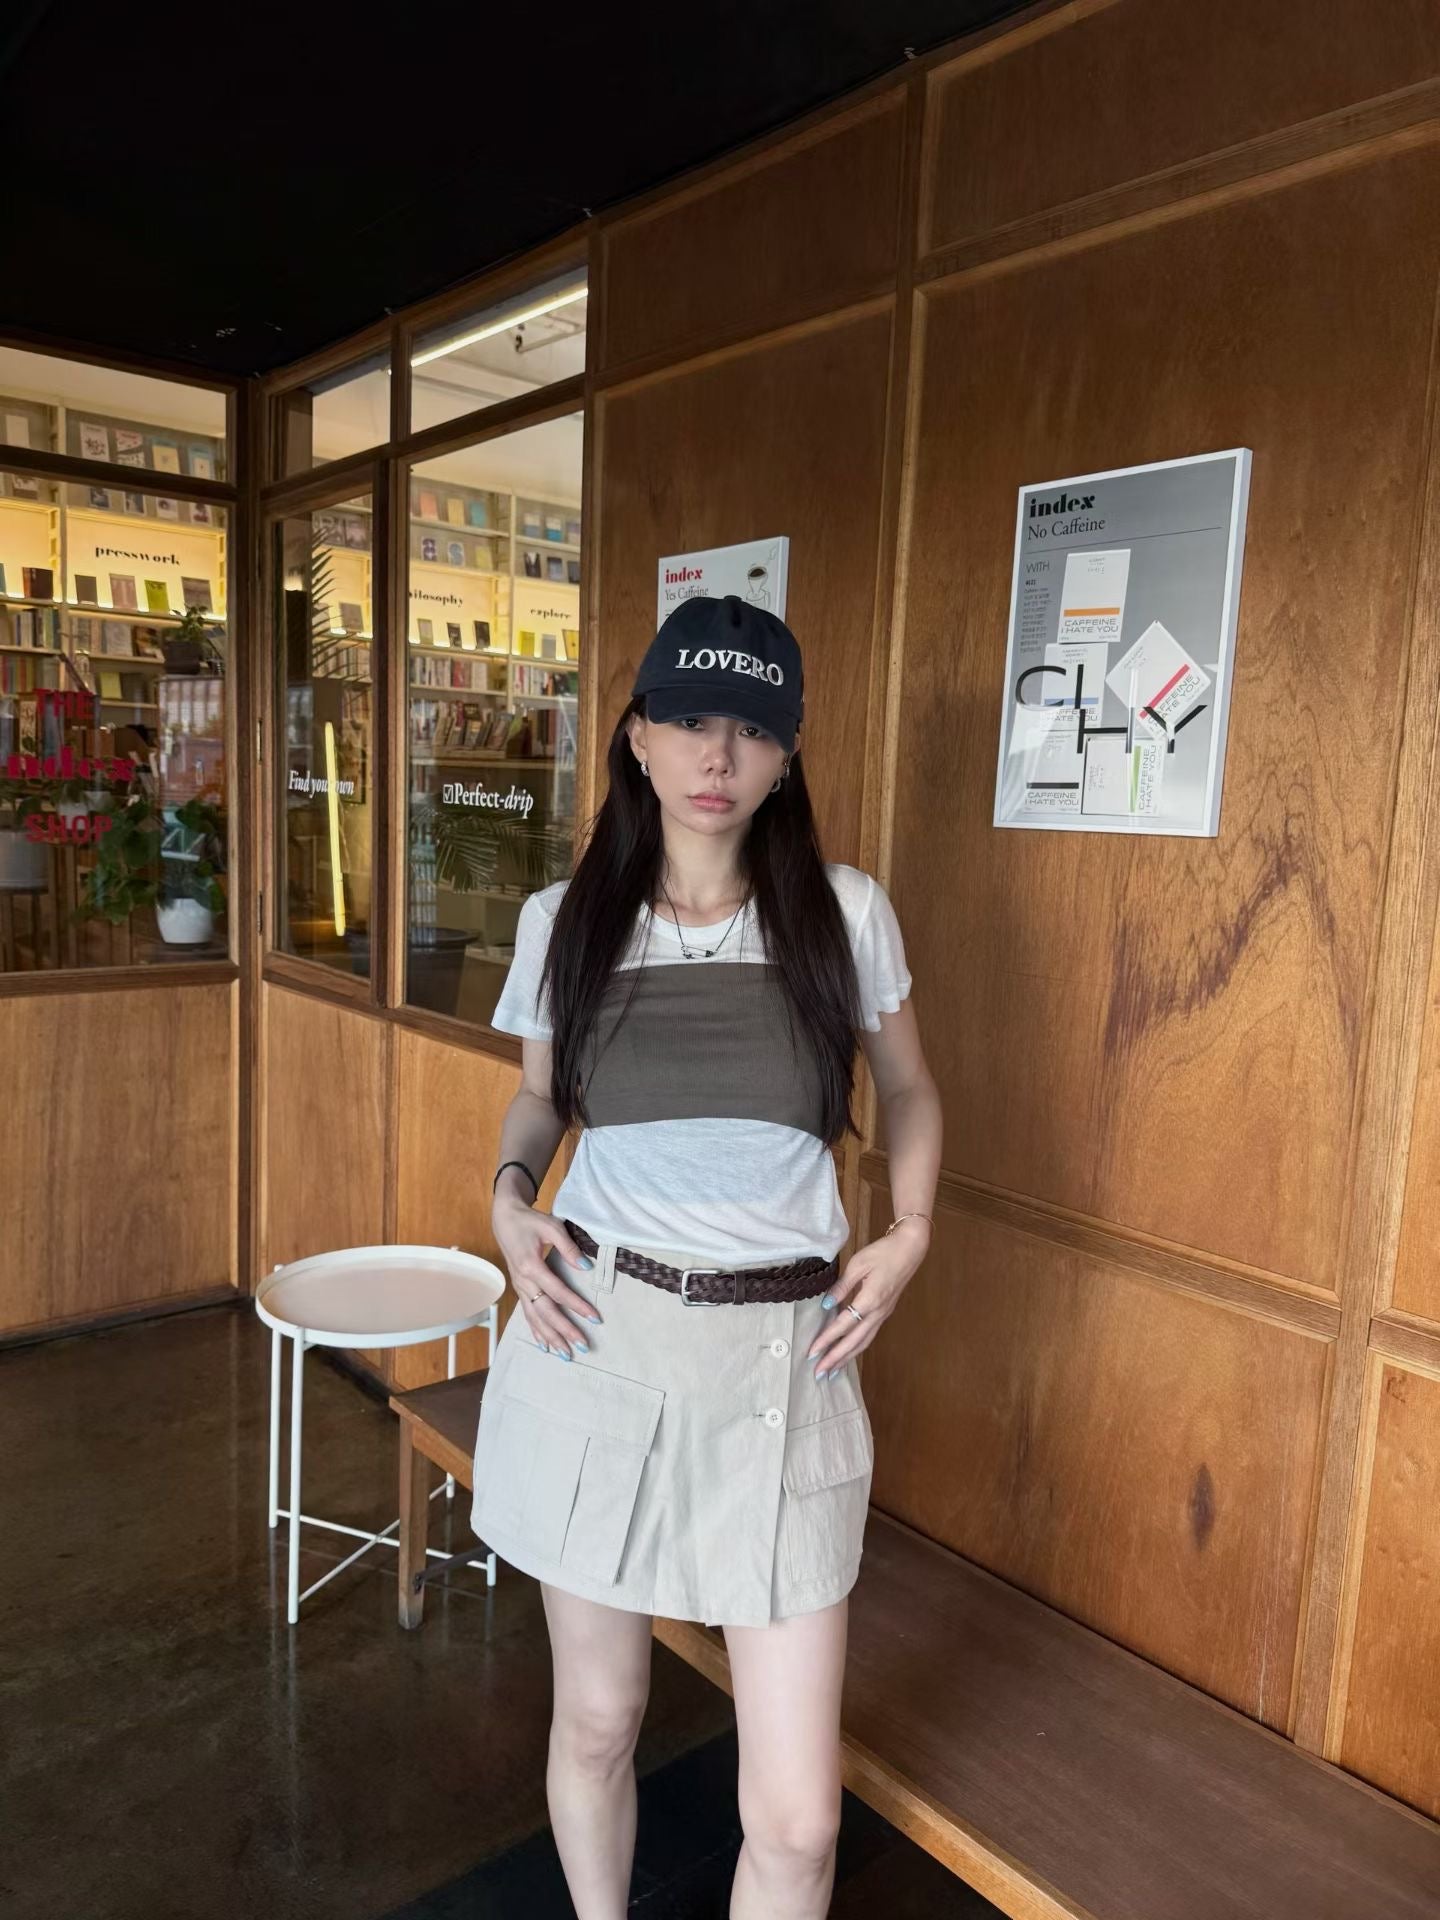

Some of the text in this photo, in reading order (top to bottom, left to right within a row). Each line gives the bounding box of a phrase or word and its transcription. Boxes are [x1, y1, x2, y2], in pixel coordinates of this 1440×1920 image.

[1029, 493, 1096, 518] index
[1028, 517, 1106, 540] No Caffeine
[95, 547, 180, 566] presswork
[1026, 561, 1050, 573] WITH
[665, 567, 703, 584] index
[409, 589, 464, 608] ilosophy
[665, 585, 709, 601] Yes Caffeine
[530, 608, 572, 620] explore
[1064, 618, 1117, 626] CAFFEINE
[675, 648, 784, 686] LOVERO
[1180, 676, 1201, 697] YOU
[34, 688, 96, 718] THE
[7, 745, 137, 781] ndex
[288, 770, 311, 793] Find
[309, 778, 330, 799] you
[1139, 749, 1150, 810] CAFFEINE
[454, 783, 534, 819] Perfect-drip
[26, 813, 113, 844] SHOP
